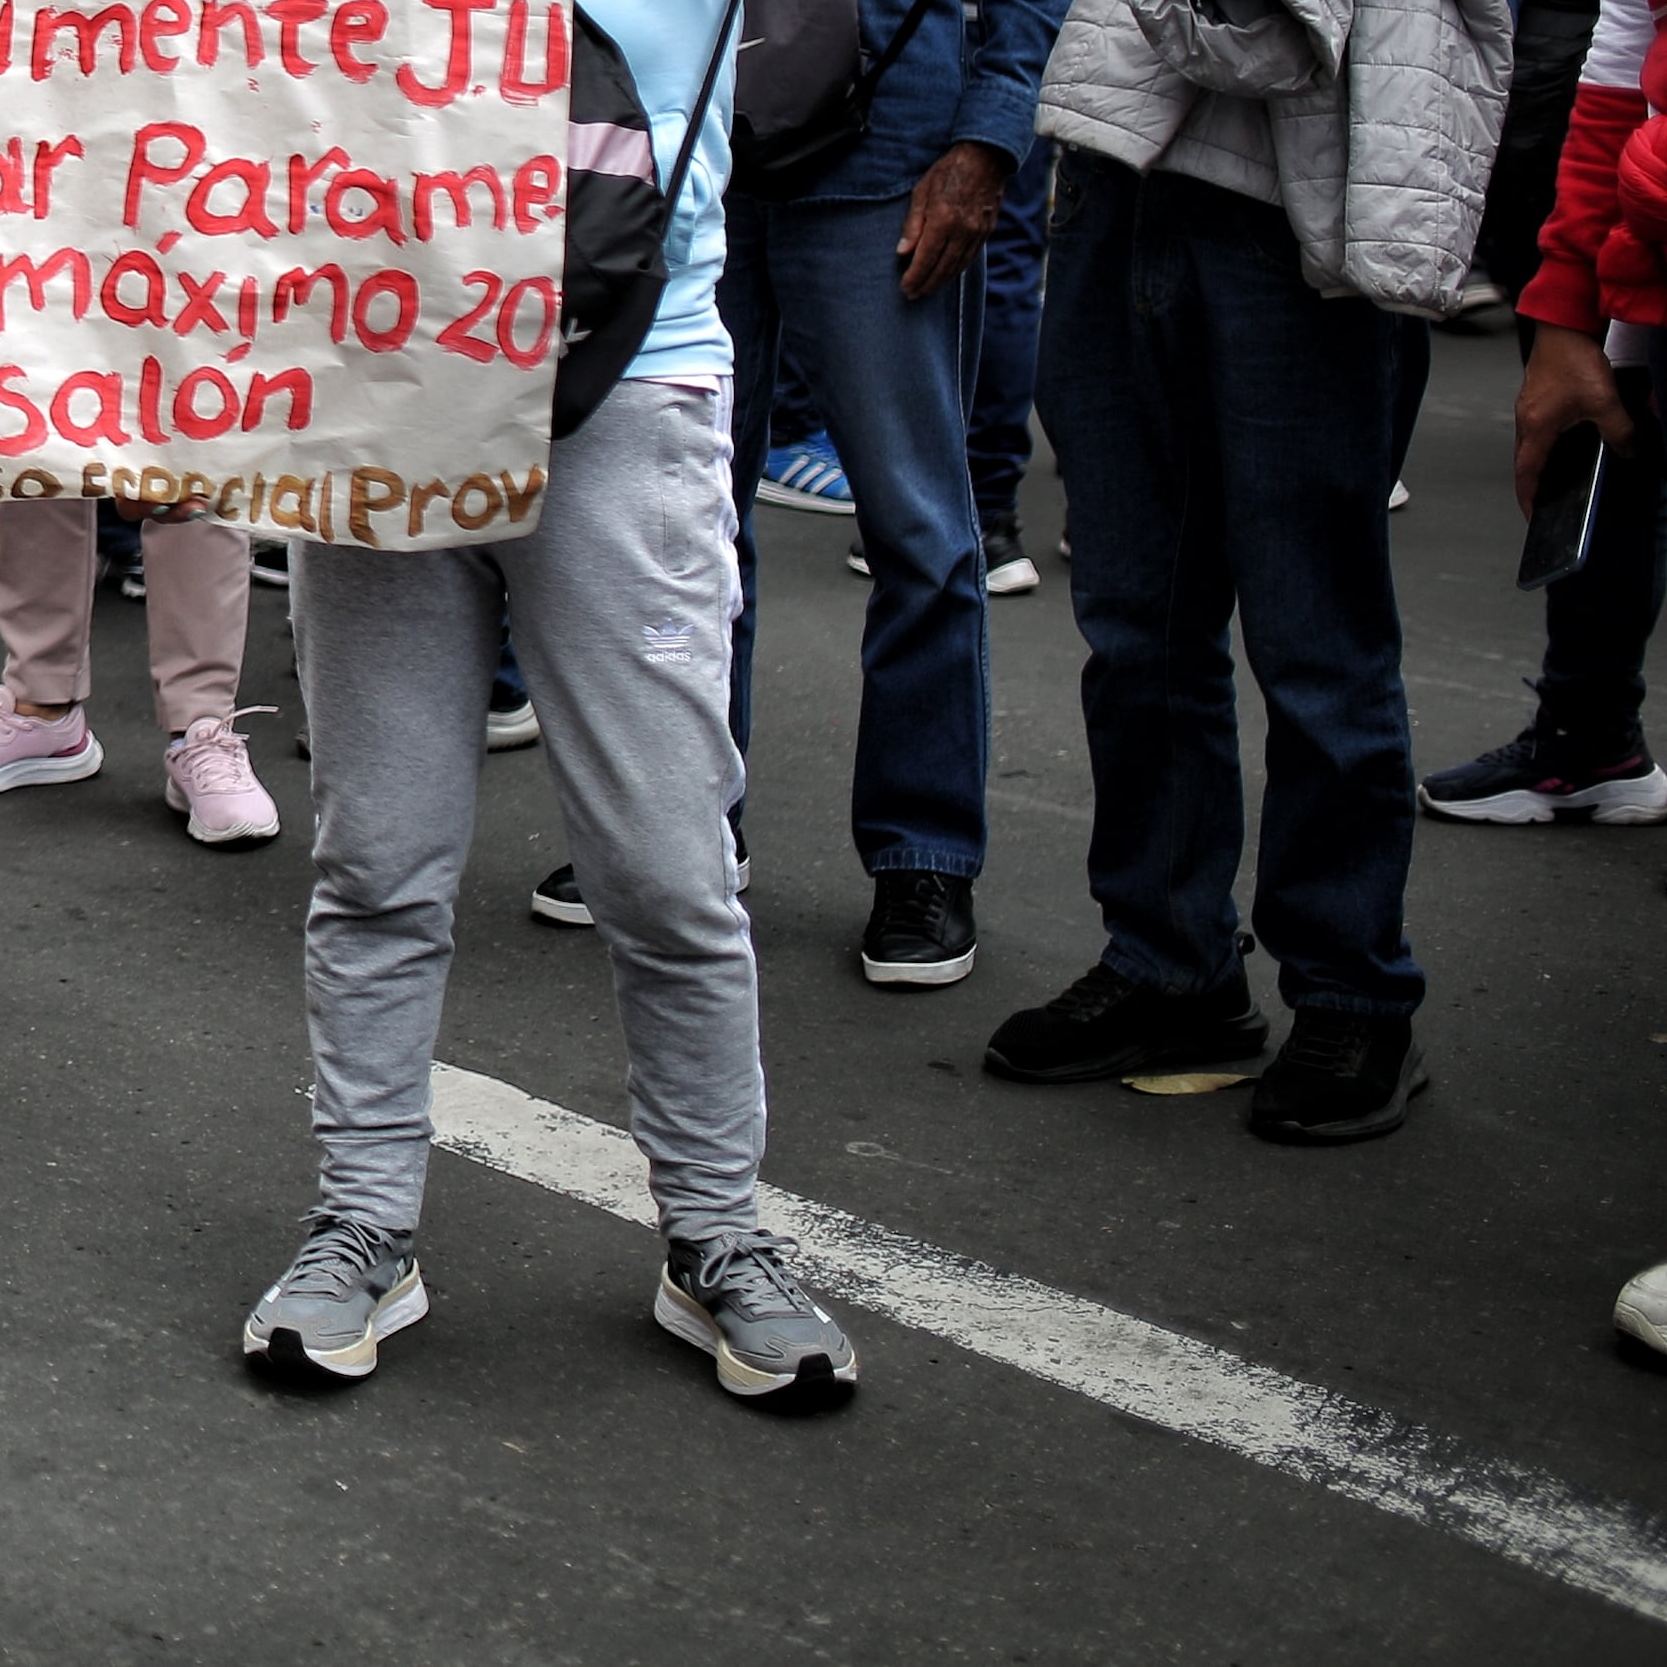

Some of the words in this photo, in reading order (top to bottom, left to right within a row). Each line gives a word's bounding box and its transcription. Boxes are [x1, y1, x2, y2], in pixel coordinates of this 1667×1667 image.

[436, 270, 563, 371] 20
[348, 464, 546, 550] Prov
[646, 650, 692, 663] adidas
